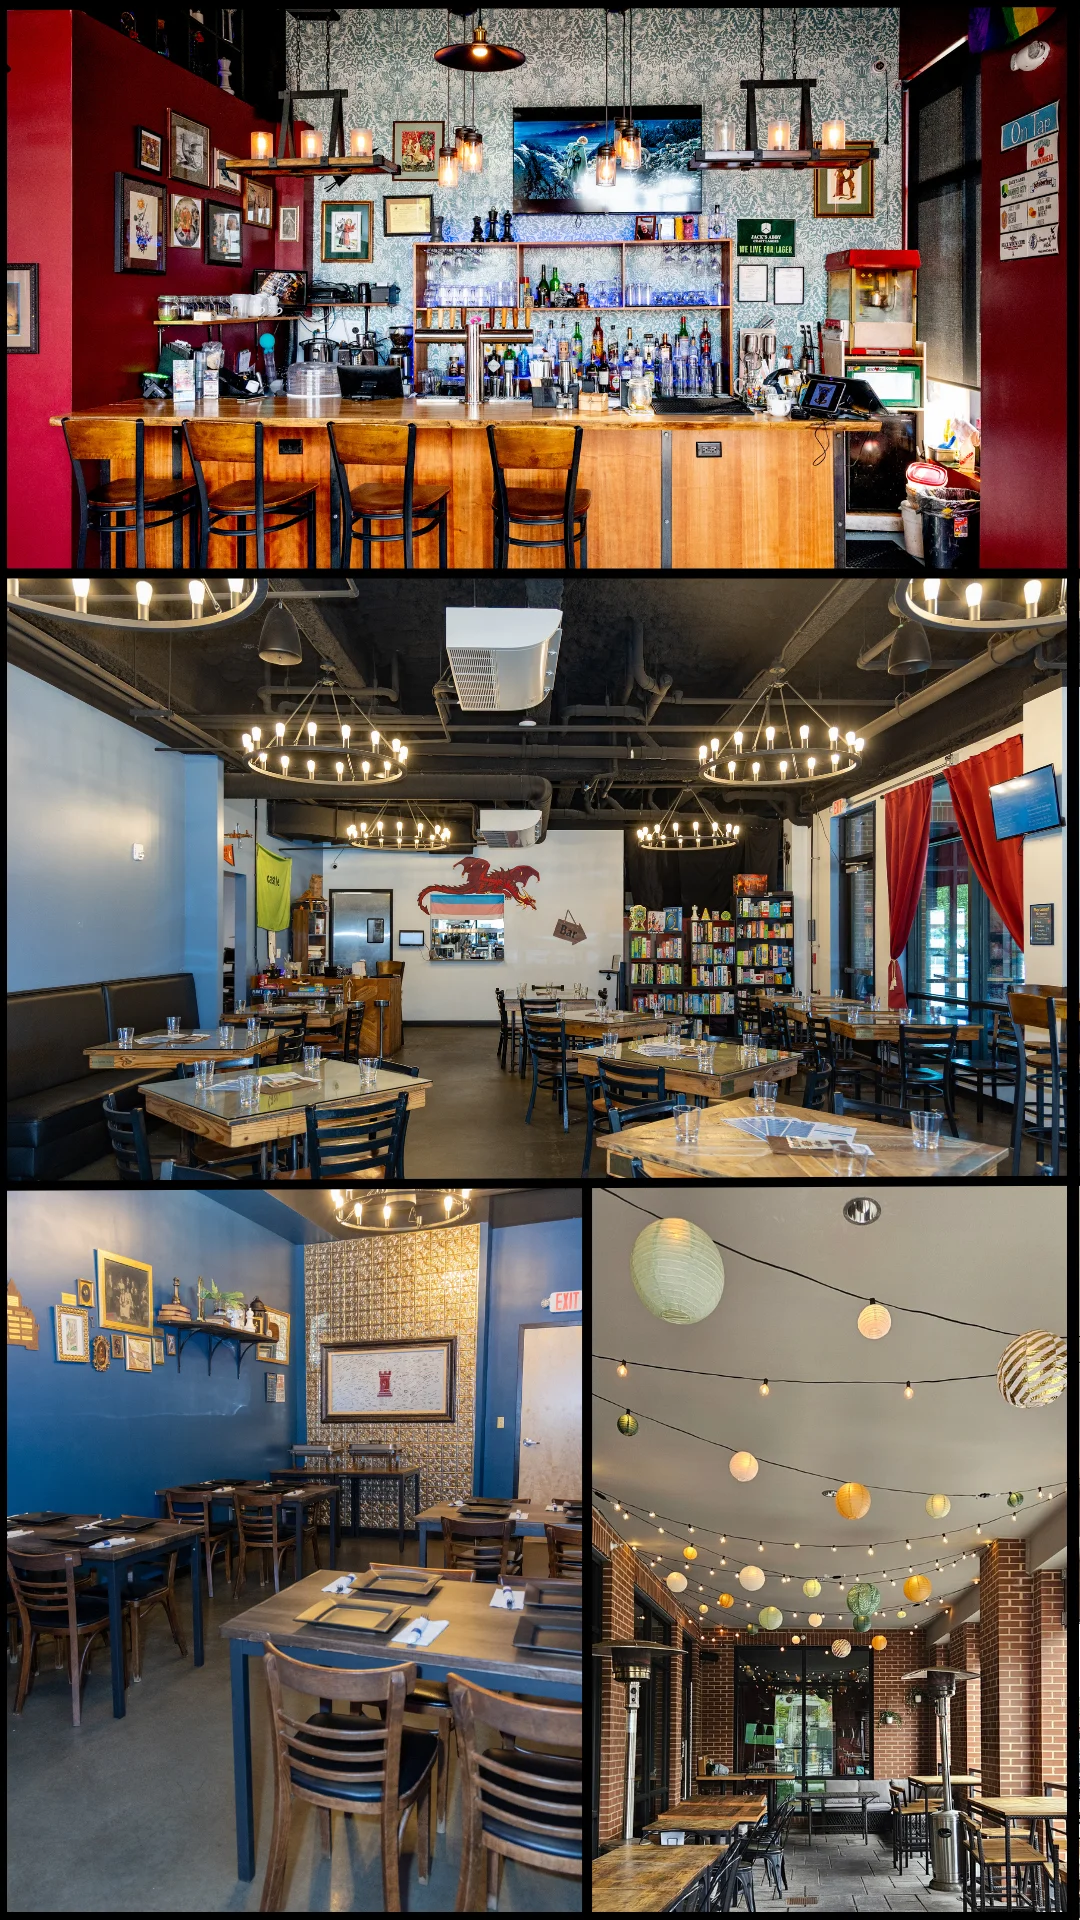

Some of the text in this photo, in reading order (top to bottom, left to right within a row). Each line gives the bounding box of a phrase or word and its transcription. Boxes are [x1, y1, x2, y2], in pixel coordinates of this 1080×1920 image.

[1011, 112, 1051, 144] On Tap
[739, 245, 793, 254] WE LIVE FOR LAGER
[560, 925, 577, 938] Bar
[556, 1292, 579, 1310] EXIT
